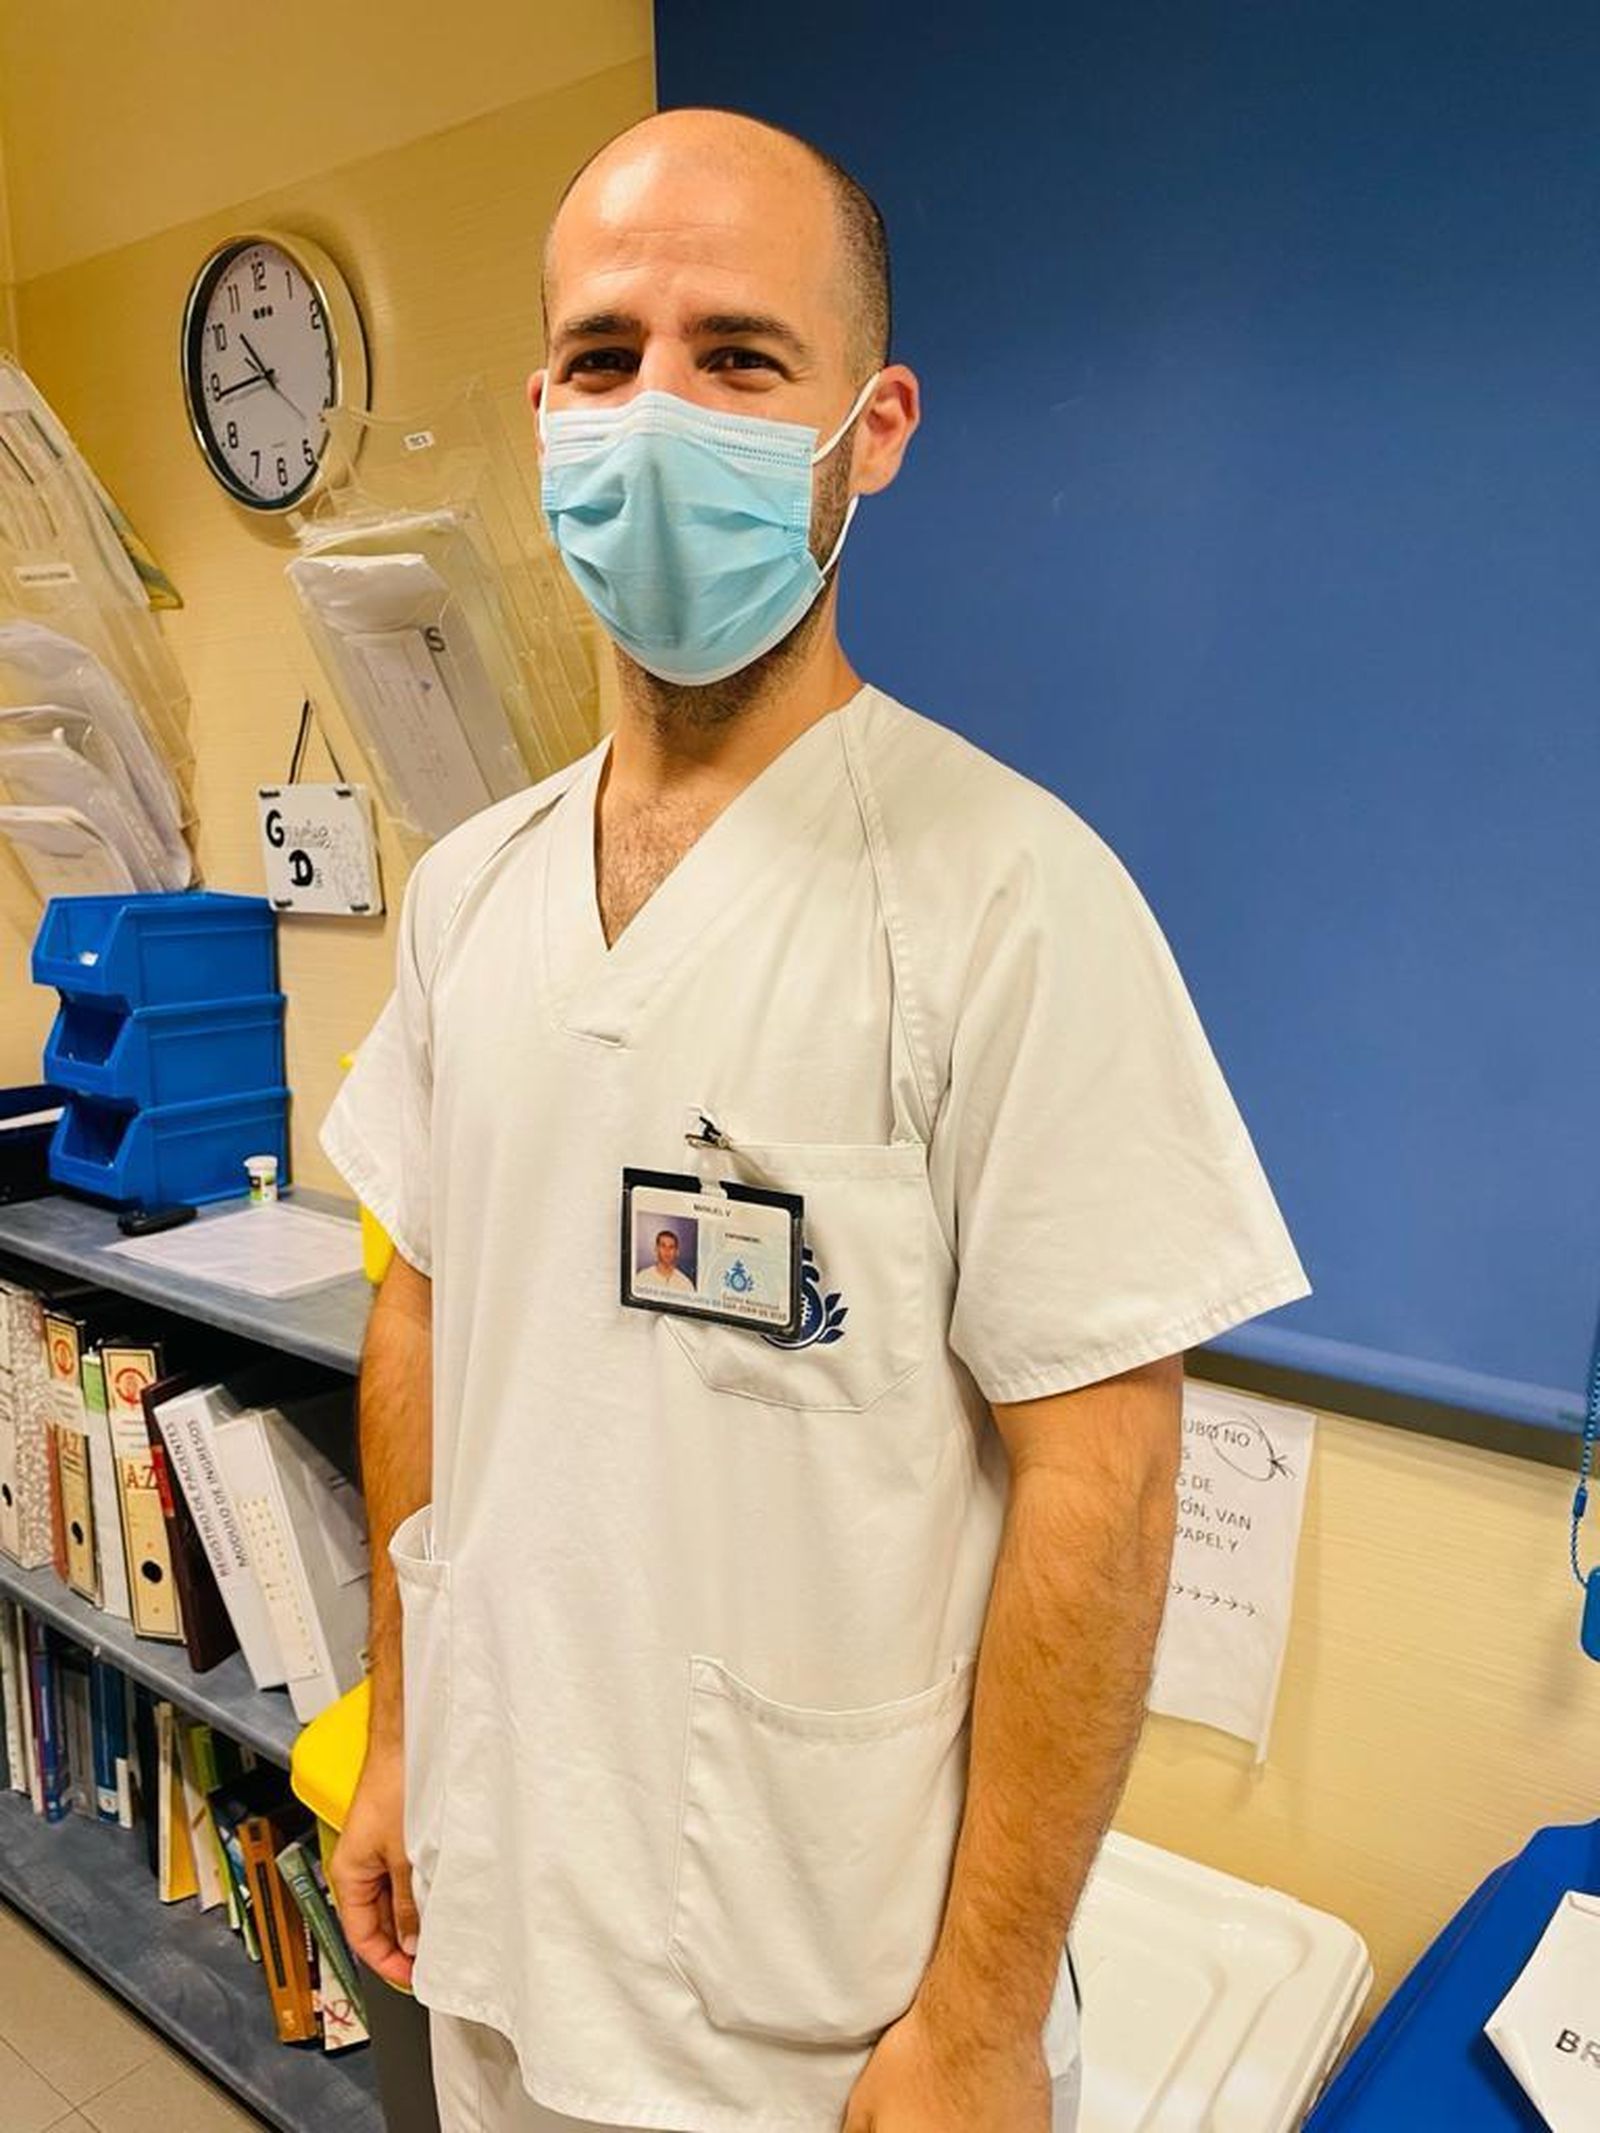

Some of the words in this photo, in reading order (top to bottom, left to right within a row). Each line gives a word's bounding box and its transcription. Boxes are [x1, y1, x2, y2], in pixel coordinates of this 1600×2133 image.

[251, 261, 267, 292] 12
[284, 270, 292, 300] 1
[227, 283, 241, 315] 11
[309, 300, 321, 330] 2
[211, 323, 227, 352] 10
[209, 373, 222, 402] 9
[226, 421, 239, 449] 8
[250, 450, 261, 479] 7
[302, 439, 316, 466] 5
[276, 457, 288, 487] 6
[424, 626, 446, 653] S
[186, 1419, 217, 1485] INGRESOS
[1224, 1429, 1250, 1448] NO
[165, 1421, 197, 1492] PACIENTES
[211, 1487, 225, 1505] DE
[1191, 1475, 1213, 1494] DE
[191, 1495, 205, 1512] DE
[1216, 1508, 1251, 1531] VAN
[200, 1514, 229, 1577] REGISTRO
[1228, 1538, 1239, 1552] Y
